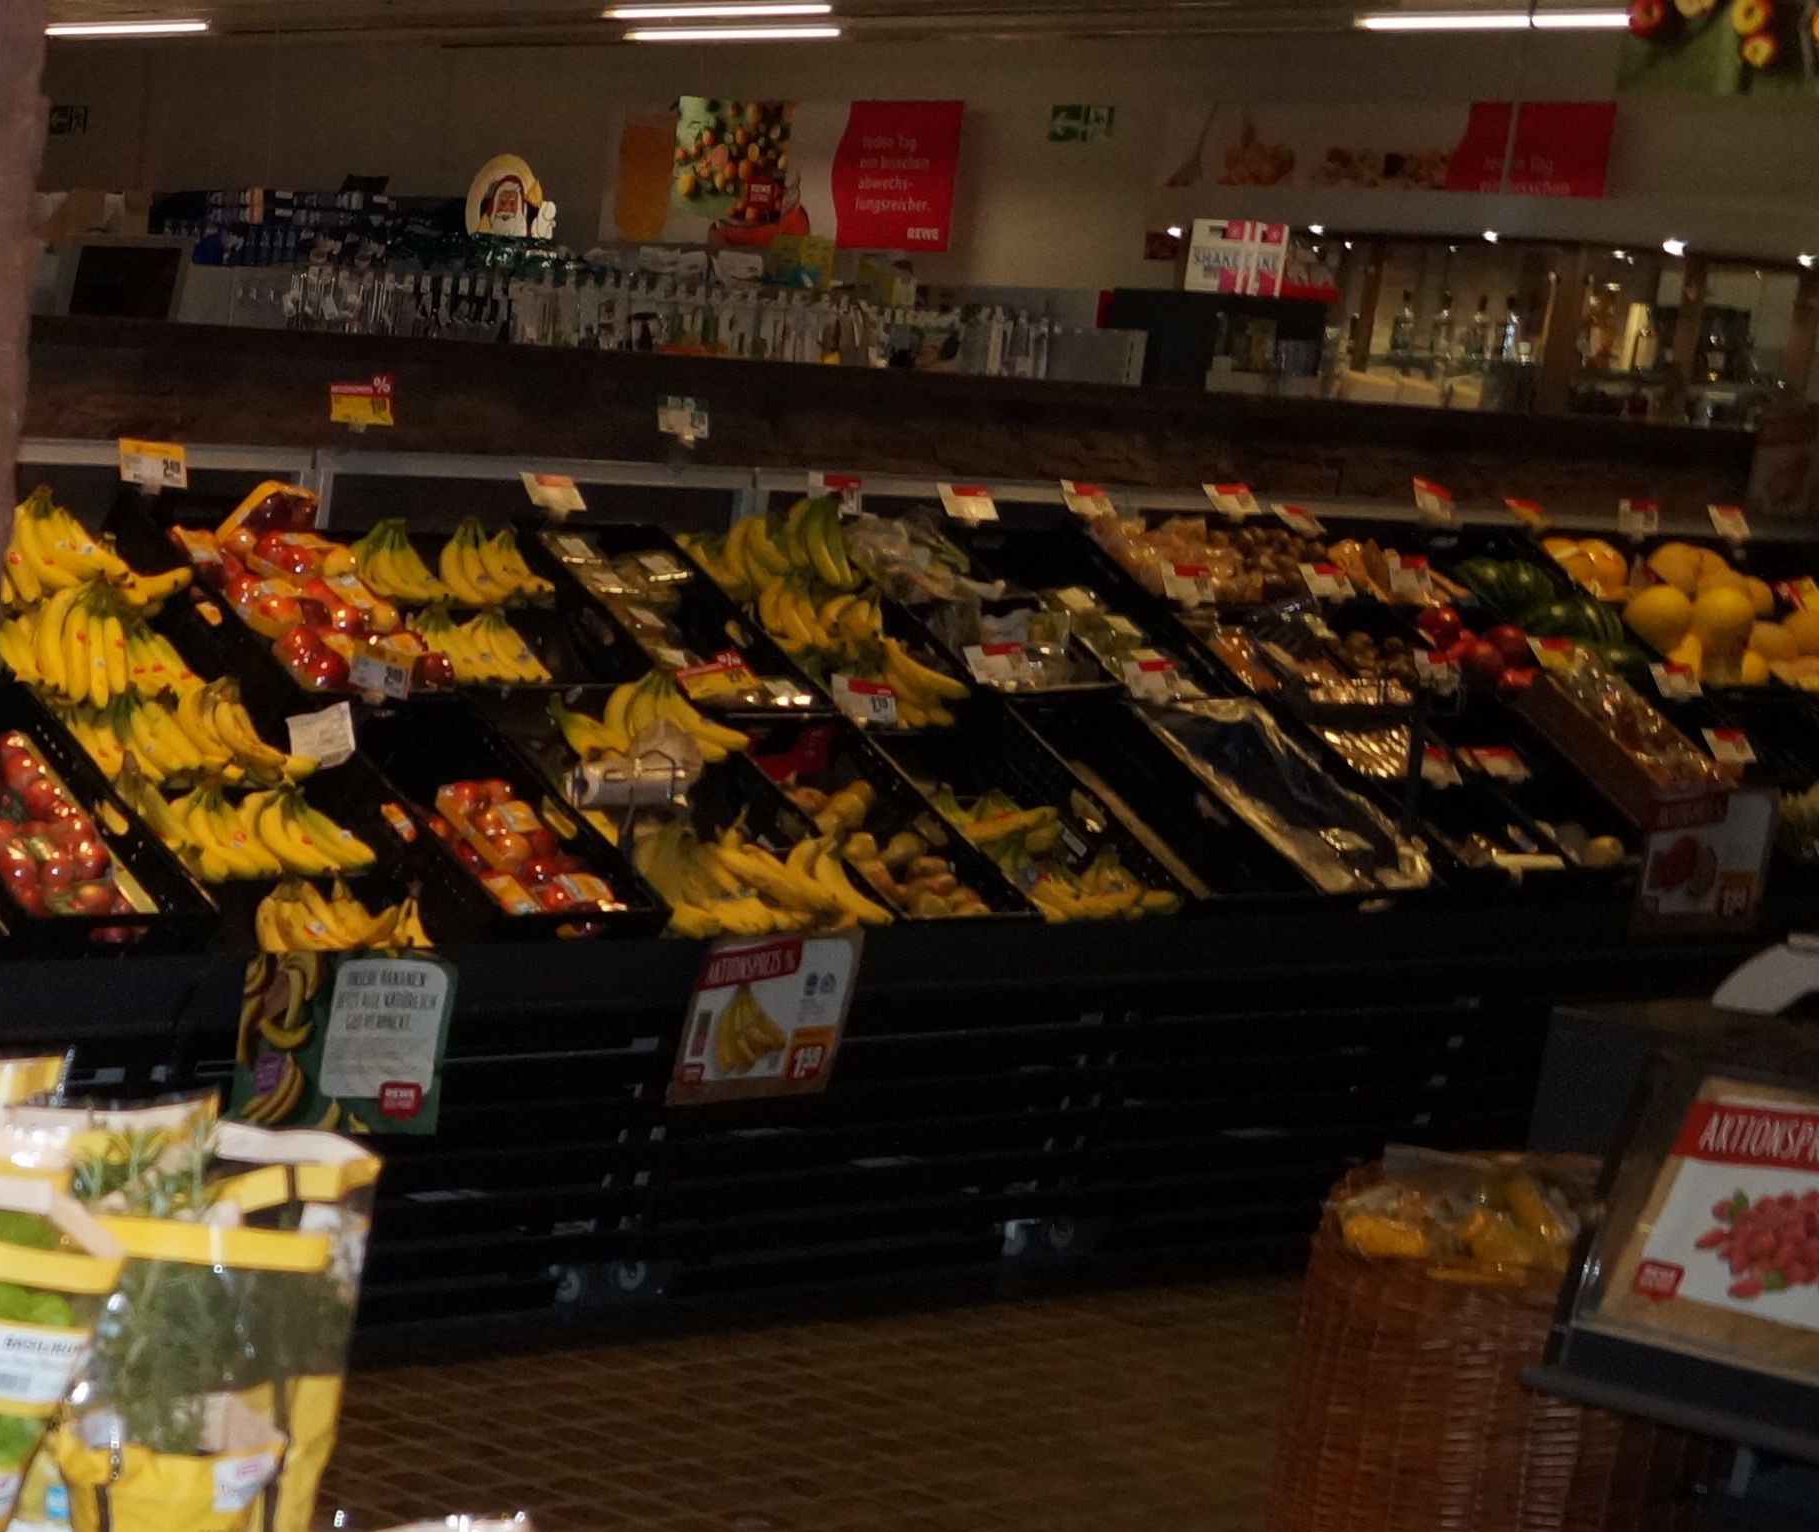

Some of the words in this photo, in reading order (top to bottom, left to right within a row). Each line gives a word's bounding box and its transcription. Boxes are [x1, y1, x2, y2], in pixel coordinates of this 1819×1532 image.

[857, 176, 913, 191] abwechs-
[854, 198, 931, 215] lungsreicher.
[906, 227, 939, 241] REWE
